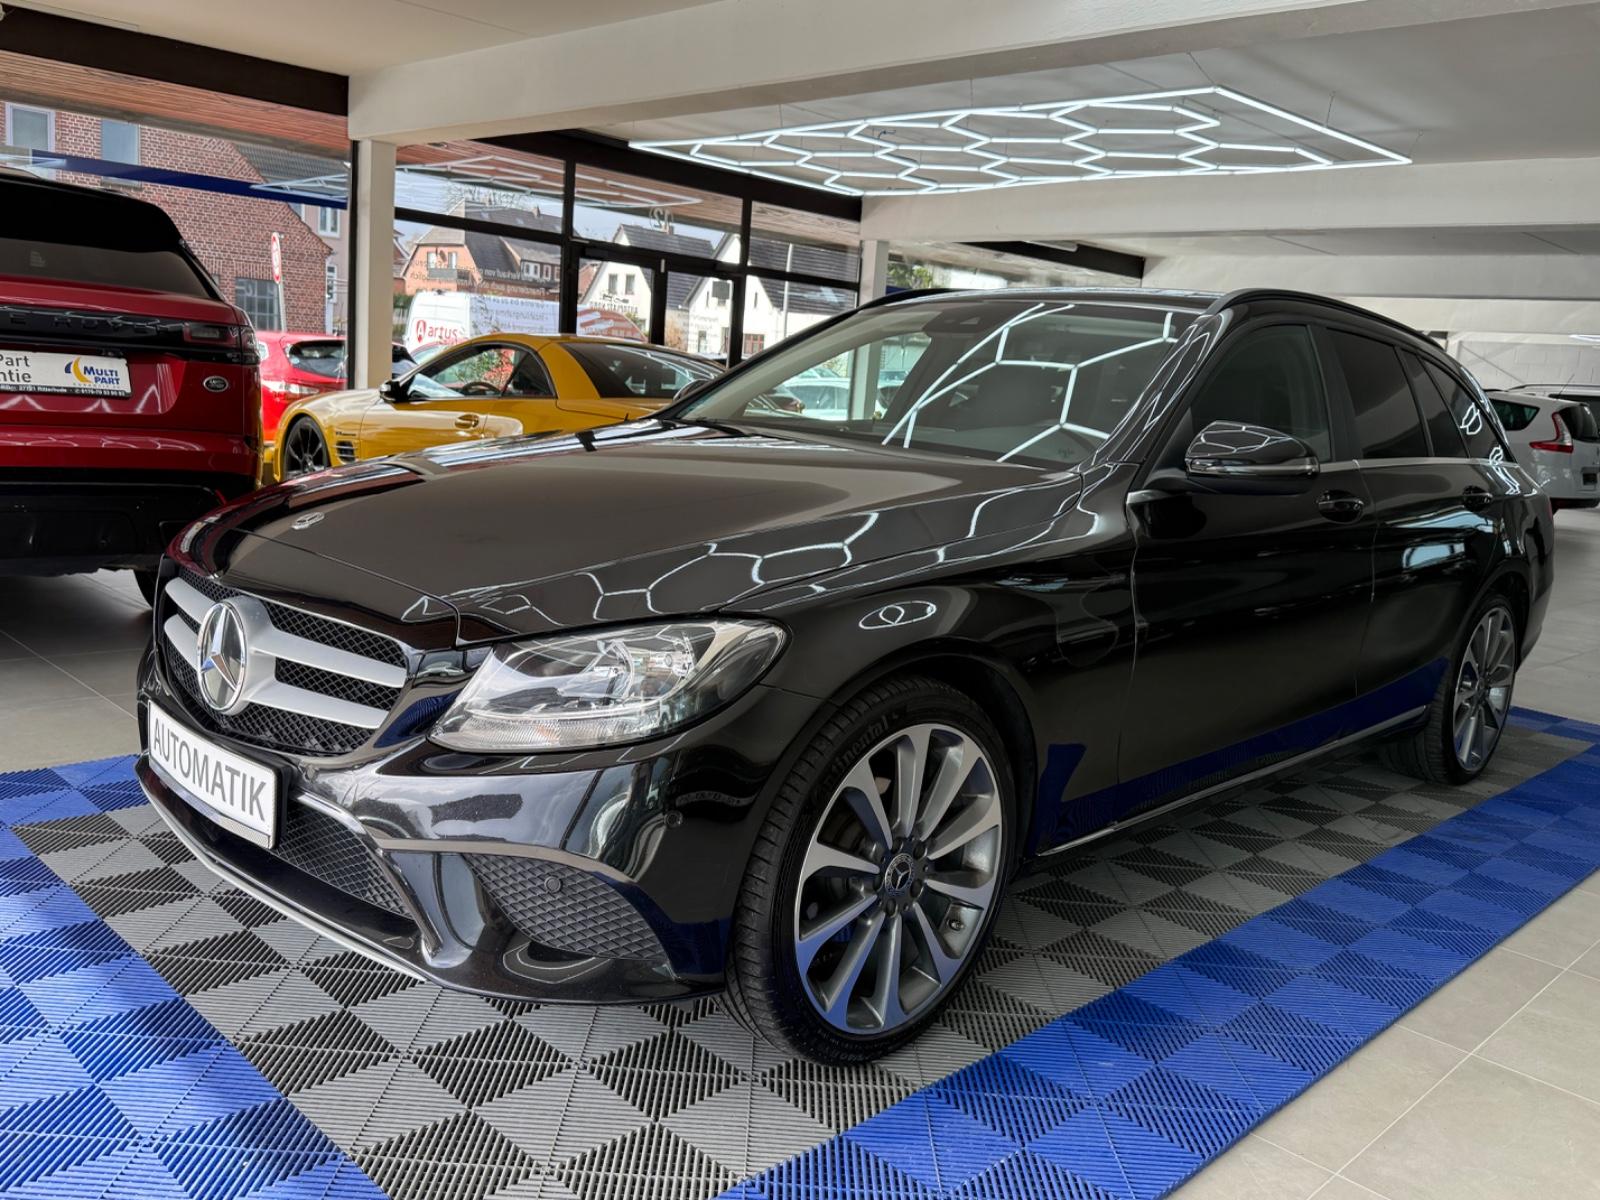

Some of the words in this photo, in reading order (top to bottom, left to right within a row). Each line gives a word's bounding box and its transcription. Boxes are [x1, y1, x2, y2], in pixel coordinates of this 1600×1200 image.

[427, 326, 458, 341] artus
[83, 366, 119, 377] MULTI
[94, 376, 120, 385] PART
[153, 717, 267, 822] AUTOMATIK
